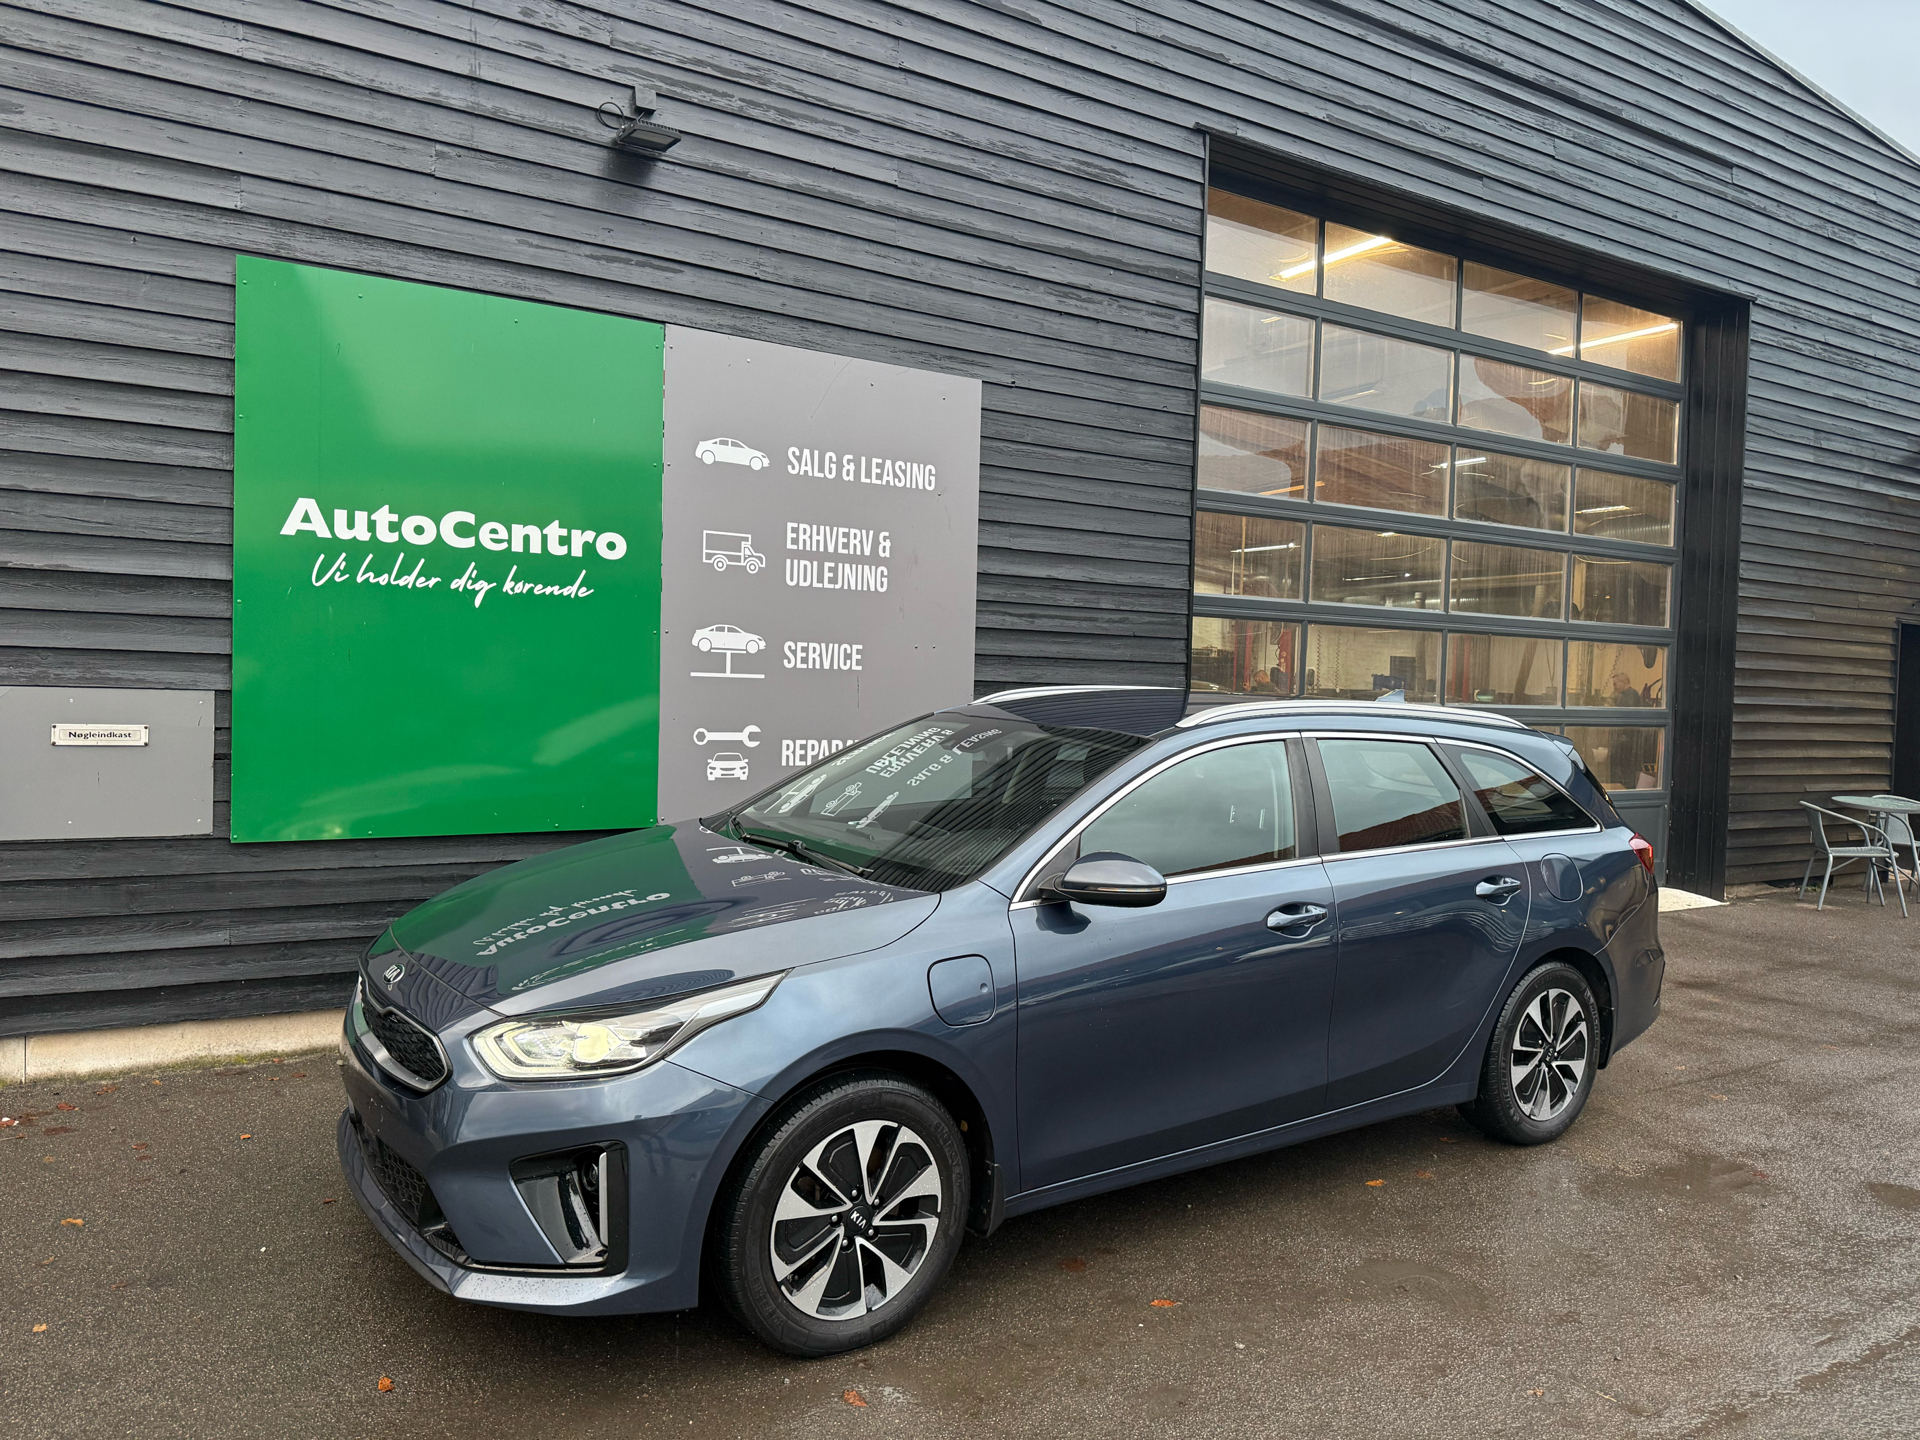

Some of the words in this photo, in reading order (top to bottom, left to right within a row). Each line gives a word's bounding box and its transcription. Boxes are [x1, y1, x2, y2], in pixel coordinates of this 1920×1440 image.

[787, 446, 838, 480] SALG
[842, 455, 856, 482] &
[860, 456, 937, 491] LEASING
[280, 497, 628, 561] AutoCentro
[786, 522, 874, 557] ERHVERV
[878, 531, 892, 558] &
[311, 552, 350, 587] Vi
[356, 552, 442, 589] holder
[450, 561, 497, 608] dig
[502, 565, 595, 598] kørende
[785, 559, 889, 593] UDLEJNING
[783, 641, 863, 671] SERVICE
[68, 731, 132, 740] Nøgleindkast
[781, 739, 860, 767] REPAR
[850, 1210, 866, 1229] KIA
